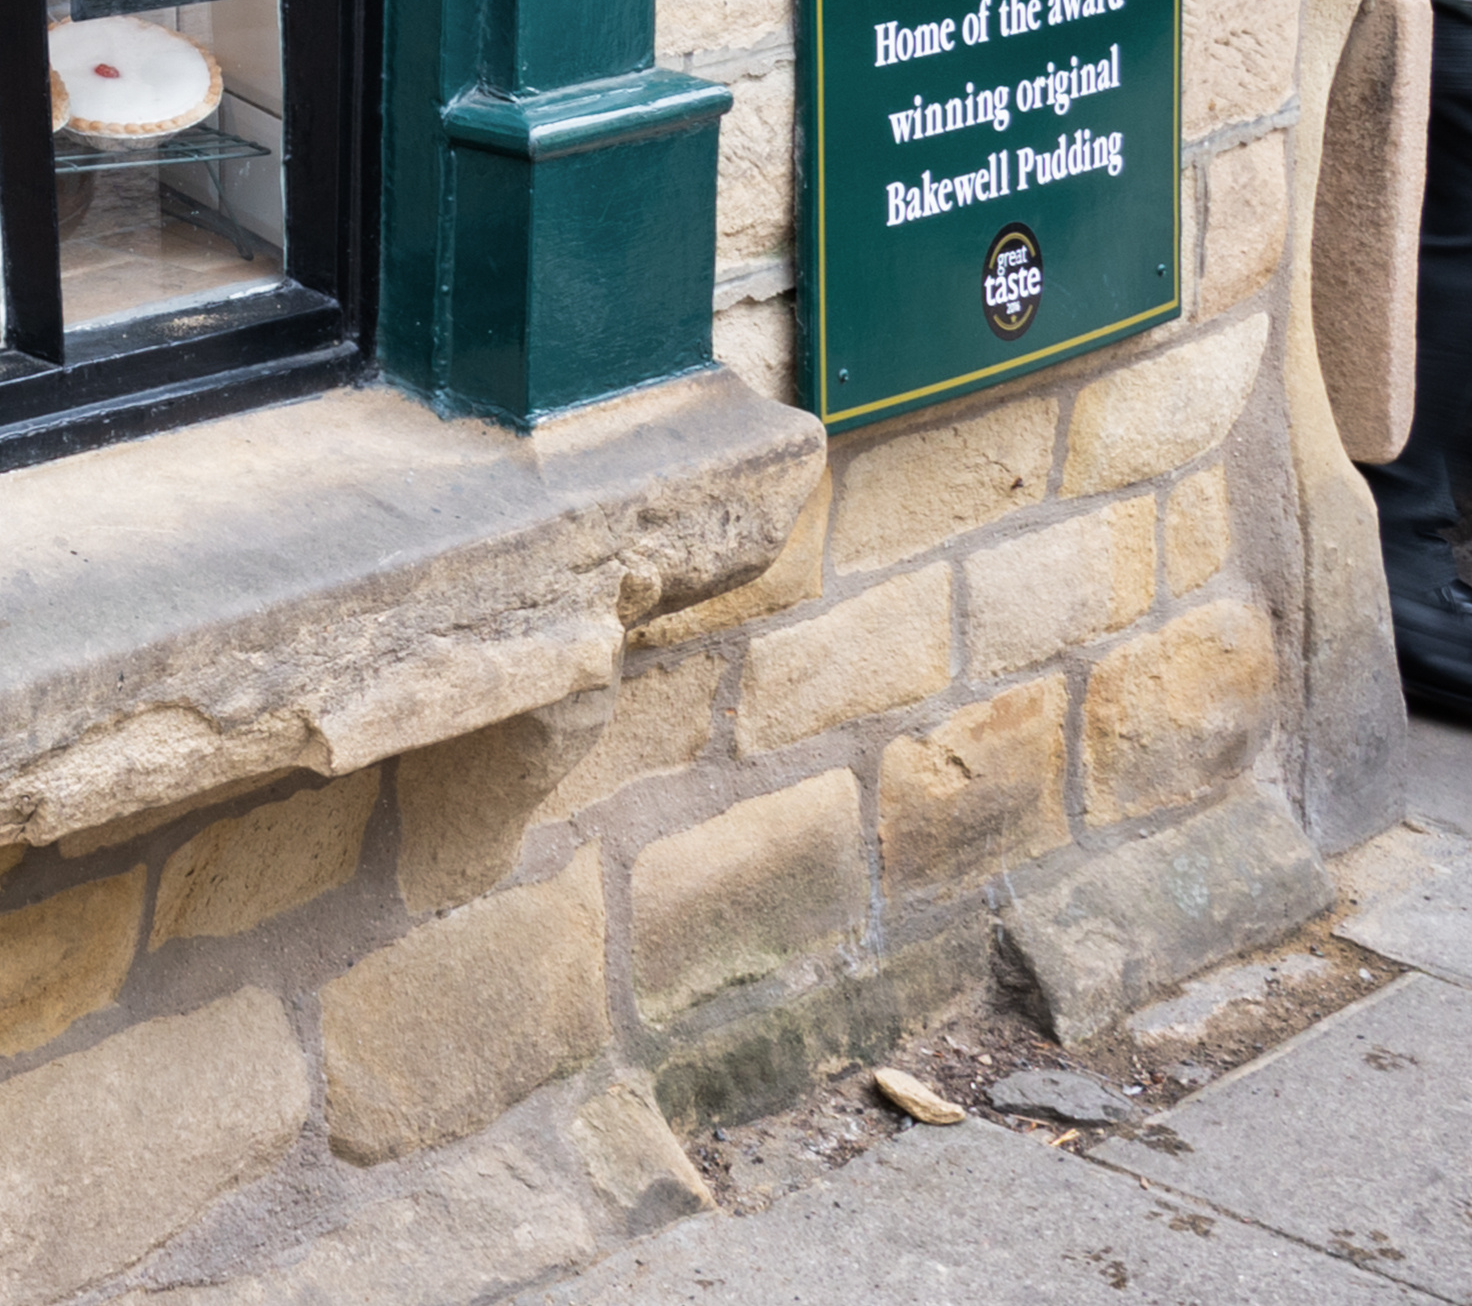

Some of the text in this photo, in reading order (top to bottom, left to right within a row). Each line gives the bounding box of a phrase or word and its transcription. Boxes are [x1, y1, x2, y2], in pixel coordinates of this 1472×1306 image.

[875, 19, 955, 67] Home
[889, 44, 1120, 143] winning original
[886, 132, 1122, 226] Bakewell Pudding
[997, 245, 1028, 276] great
[984, 267, 1041, 306] taste
